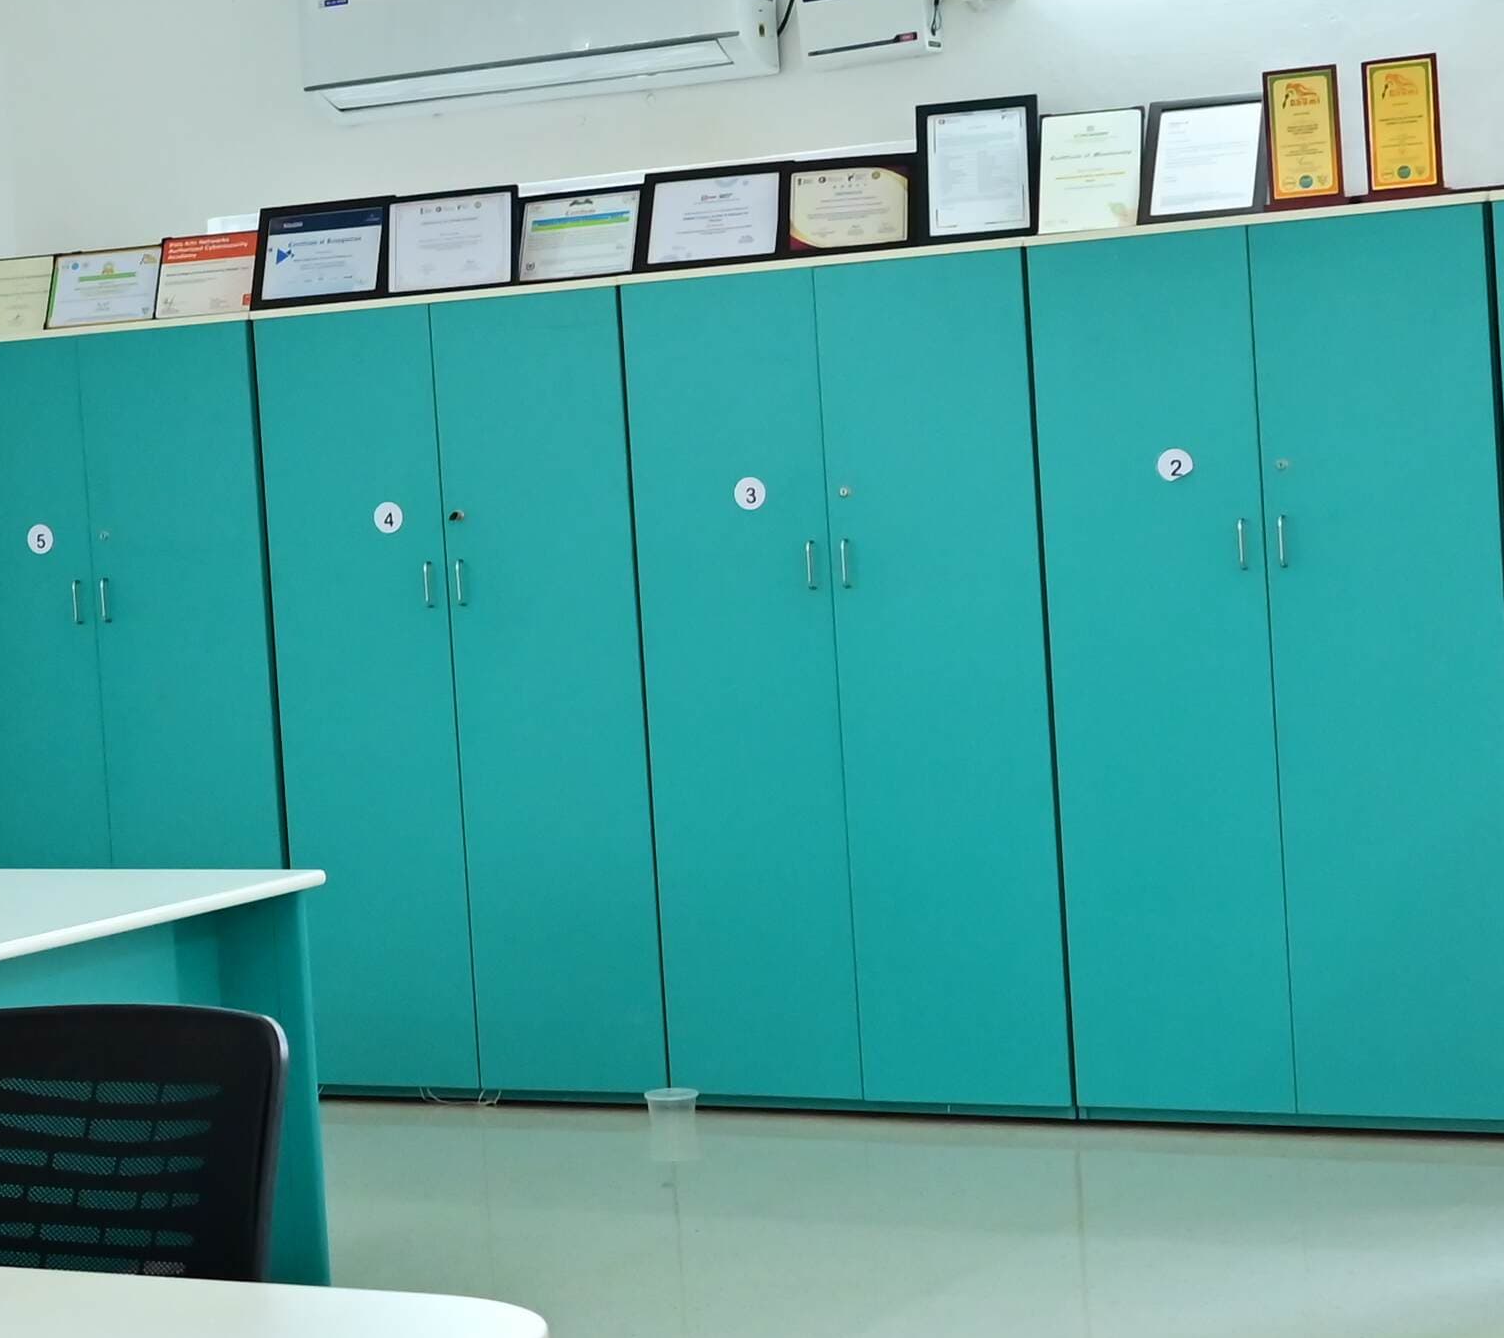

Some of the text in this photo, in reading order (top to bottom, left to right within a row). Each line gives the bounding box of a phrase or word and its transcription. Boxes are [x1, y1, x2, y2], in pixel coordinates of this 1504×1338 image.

[1170, 459, 1183, 477] 2
[745, 487, 758, 504] 3
[383, 511, 395, 528] 4
[35, 532, 47, 550] 5
